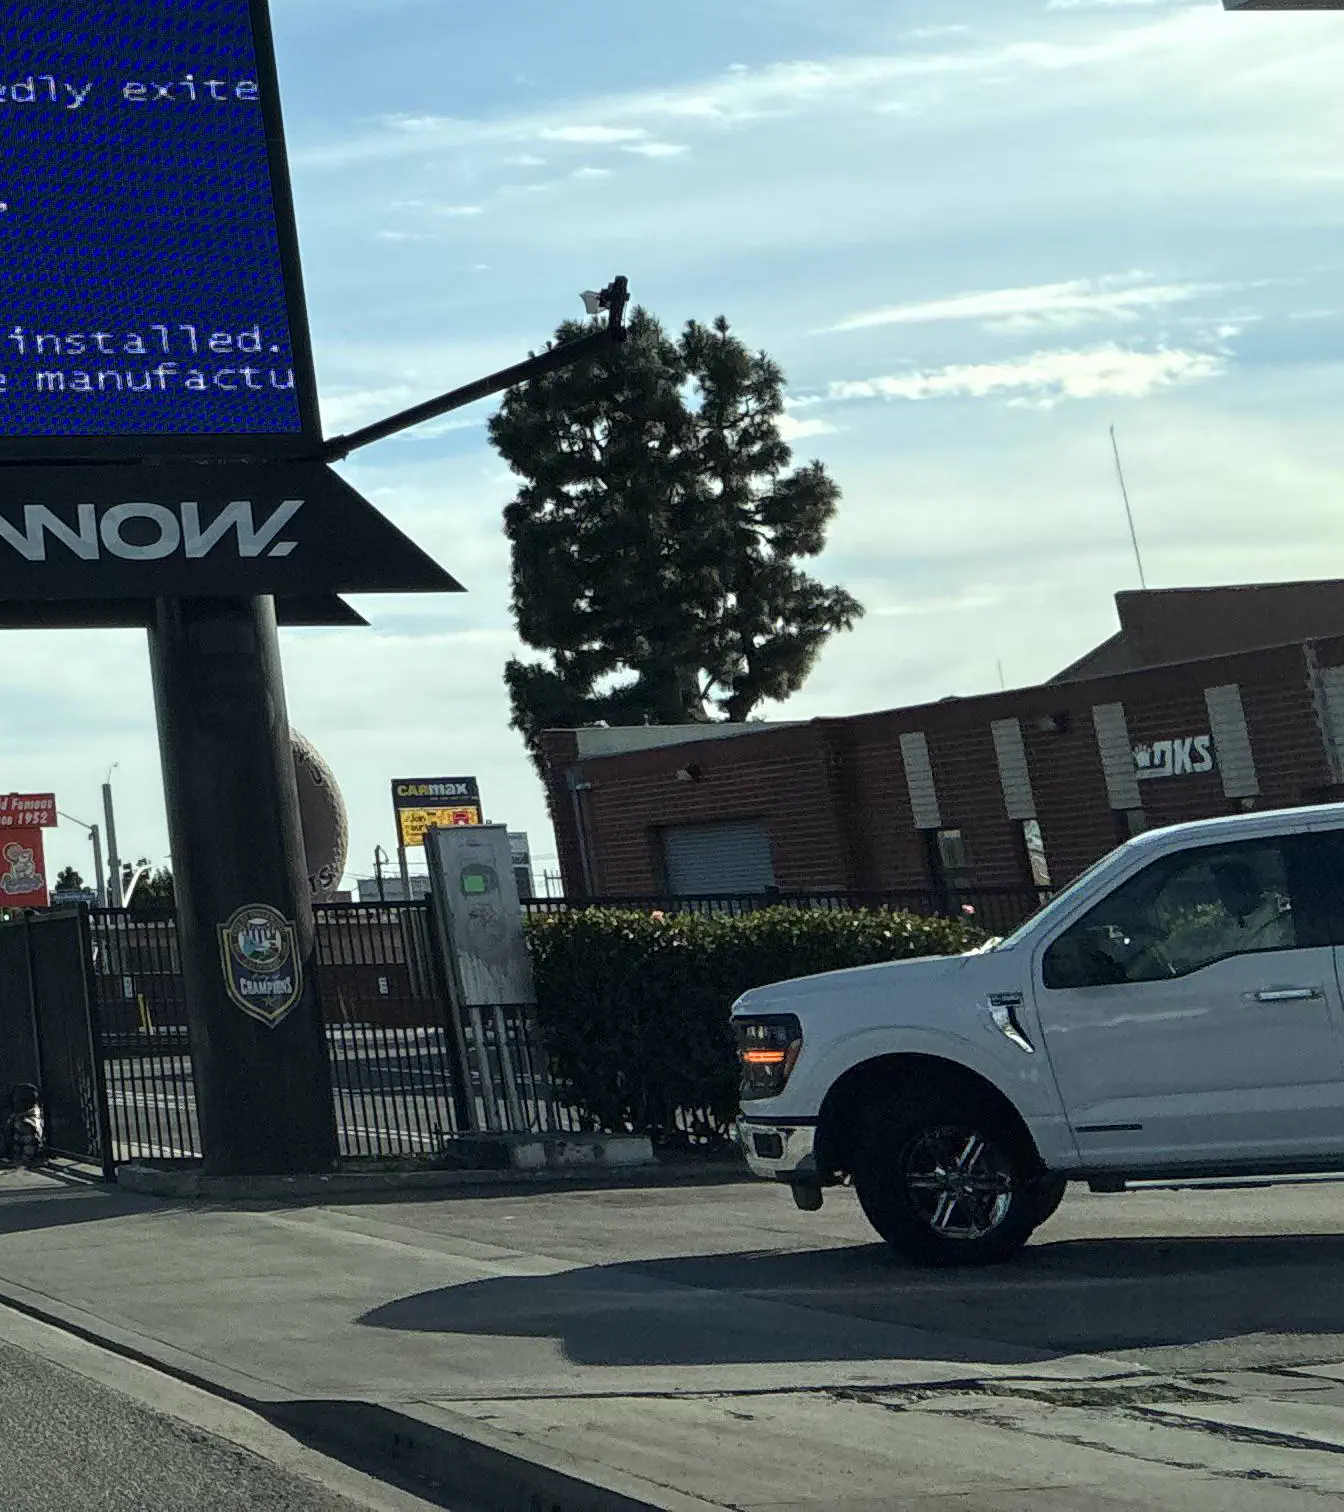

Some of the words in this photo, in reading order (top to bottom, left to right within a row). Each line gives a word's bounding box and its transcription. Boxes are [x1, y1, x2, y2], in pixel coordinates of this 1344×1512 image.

[122, 74, 258, 101] exite
[9, 324, 279, 355] installed.
[36, 362, 294, 391] manufactu
[11, 796, 53, 811] Famous
[16, 811, 49, 825] 1952
[239, 975, 293, 995] CHAMPIONS
